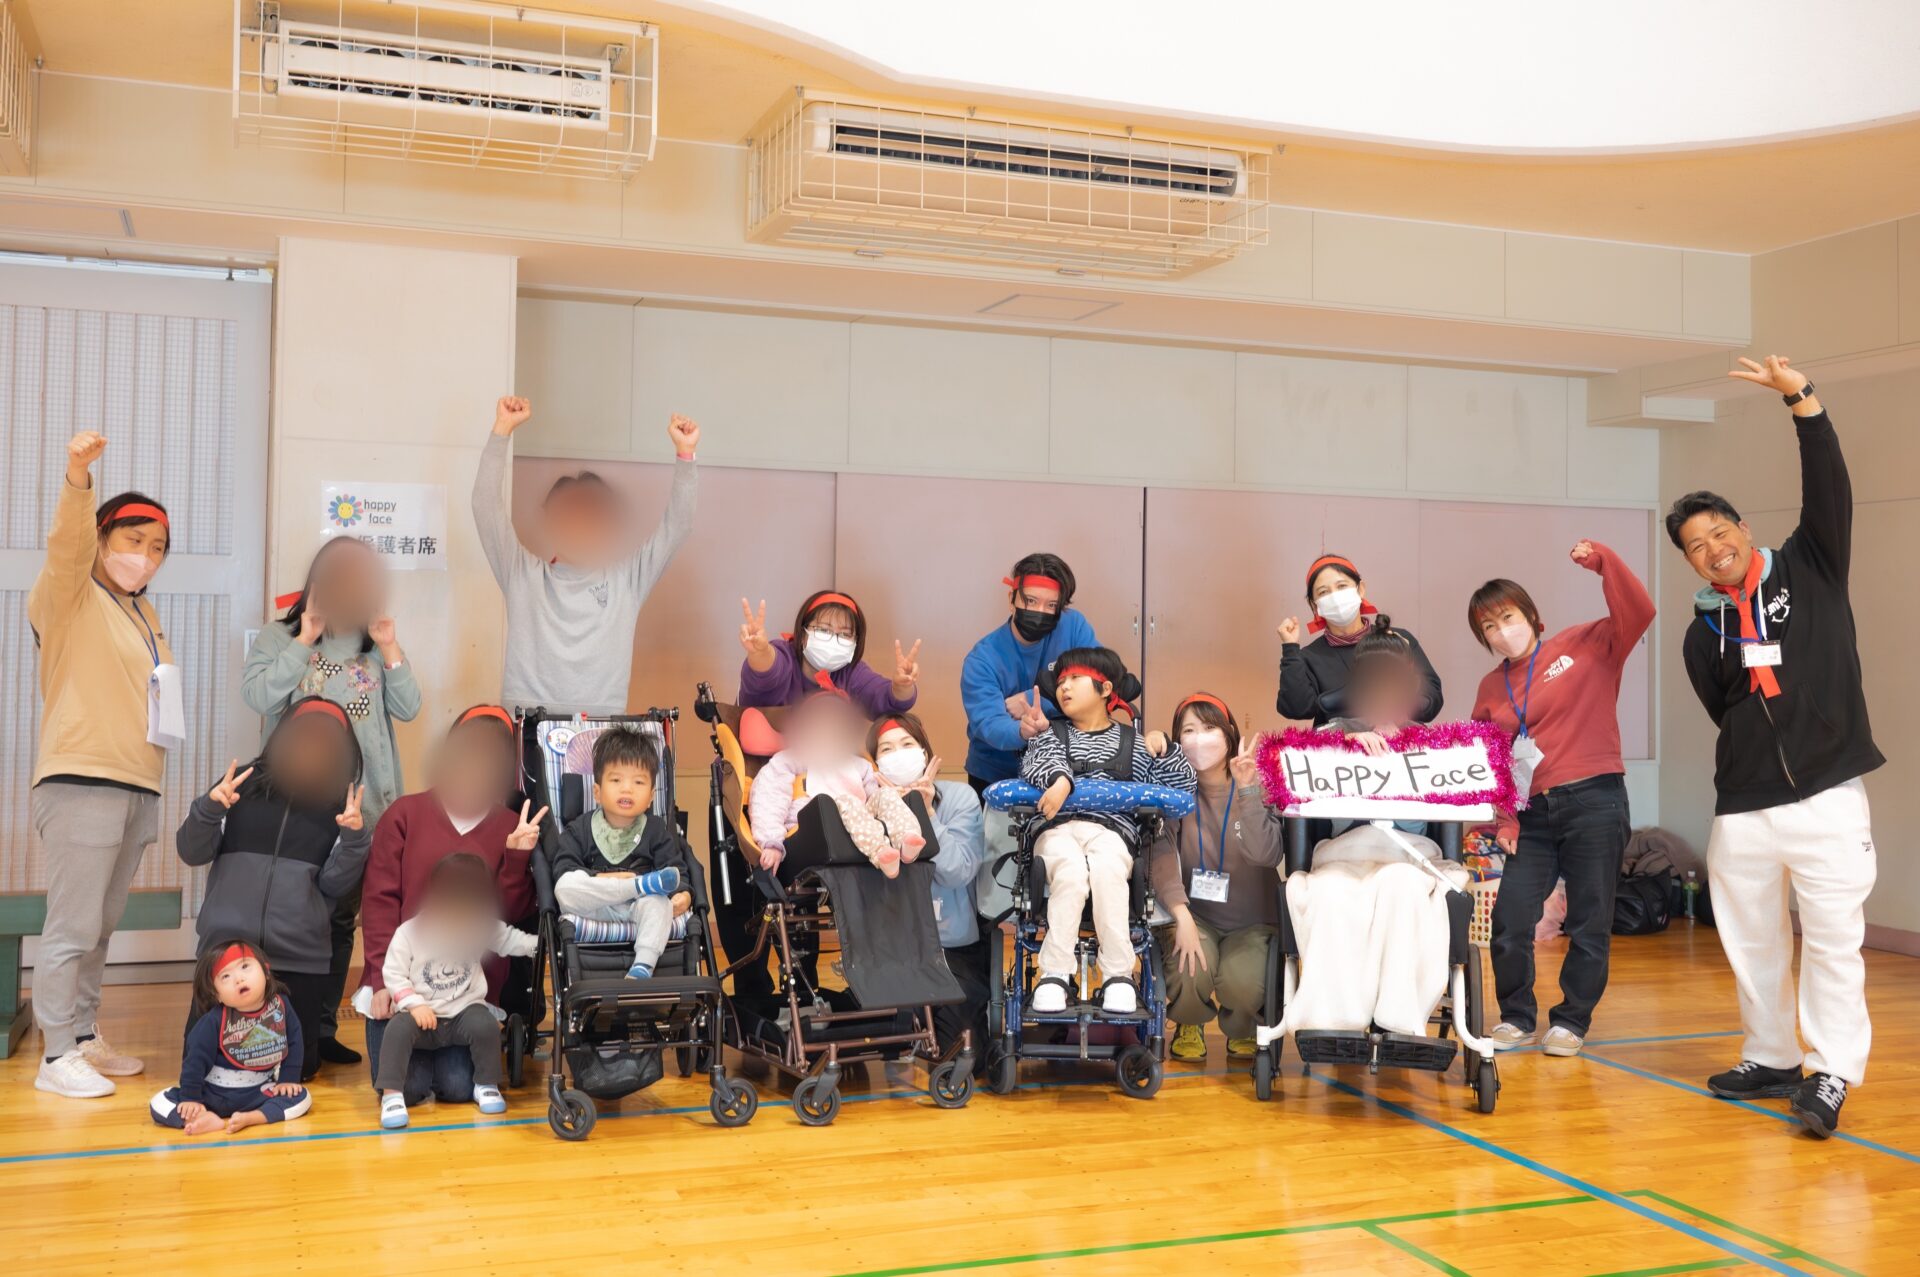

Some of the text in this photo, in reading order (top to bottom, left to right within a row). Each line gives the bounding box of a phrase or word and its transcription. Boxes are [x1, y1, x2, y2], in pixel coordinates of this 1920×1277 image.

[363, 499, 397, 513] happy
[369, 513, 393, 525] face
[1284, 751, 1488, 796] Happy Face
